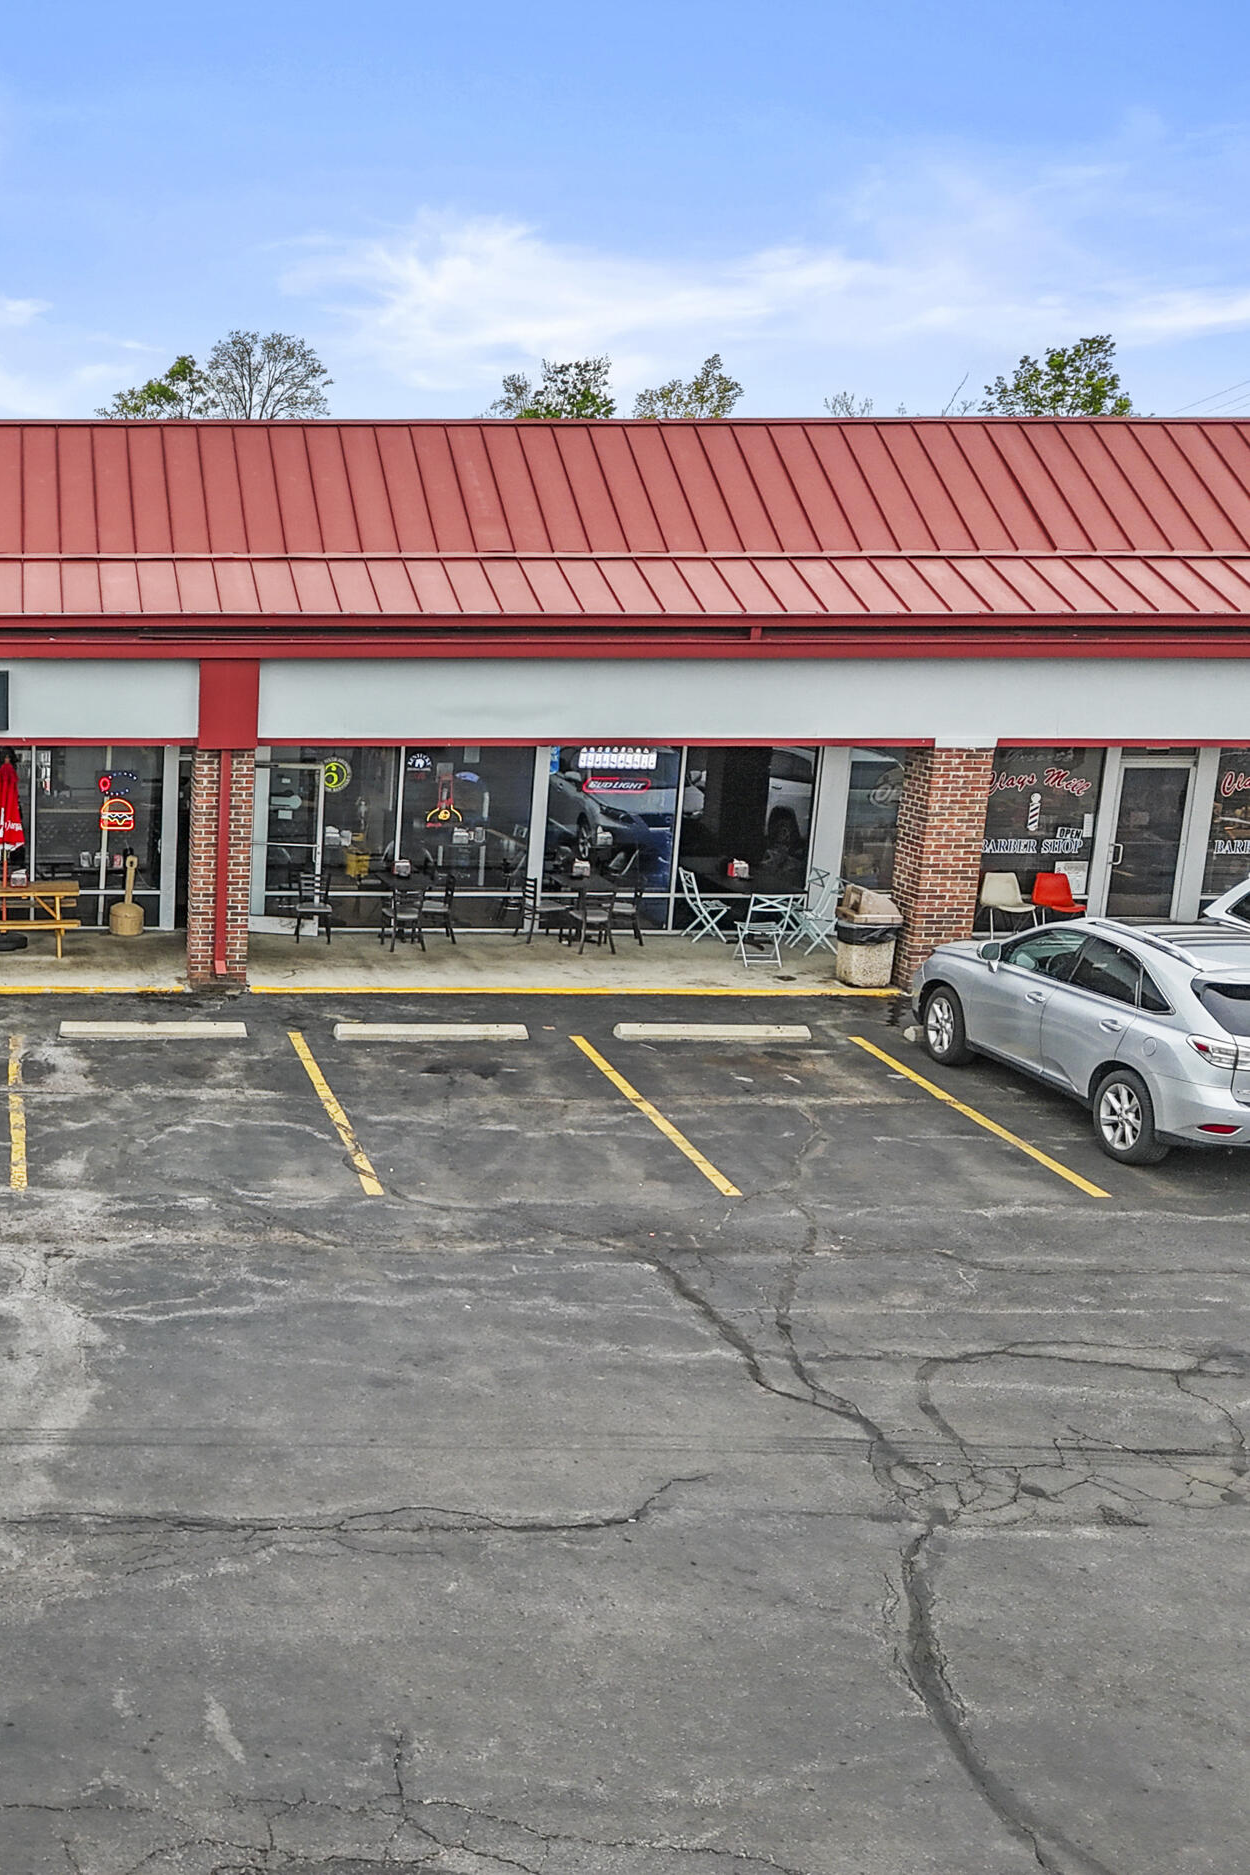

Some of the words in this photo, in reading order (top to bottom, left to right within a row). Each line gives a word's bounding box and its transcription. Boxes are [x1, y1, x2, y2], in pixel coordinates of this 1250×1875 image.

[588, 781, 613, 789] BUD
[613, 781, 645, 790] LIGHT
[1044, 767, 1091, 796] Mill
[1221, 771, 1250, 796] Cla
[1059, 828, 1081, 838] OPEN
[981, 839, 1037, 854] BARBER
[1041, 839, 1083, 854] SHOP
[1214, 840, 1250, 854] BAR
